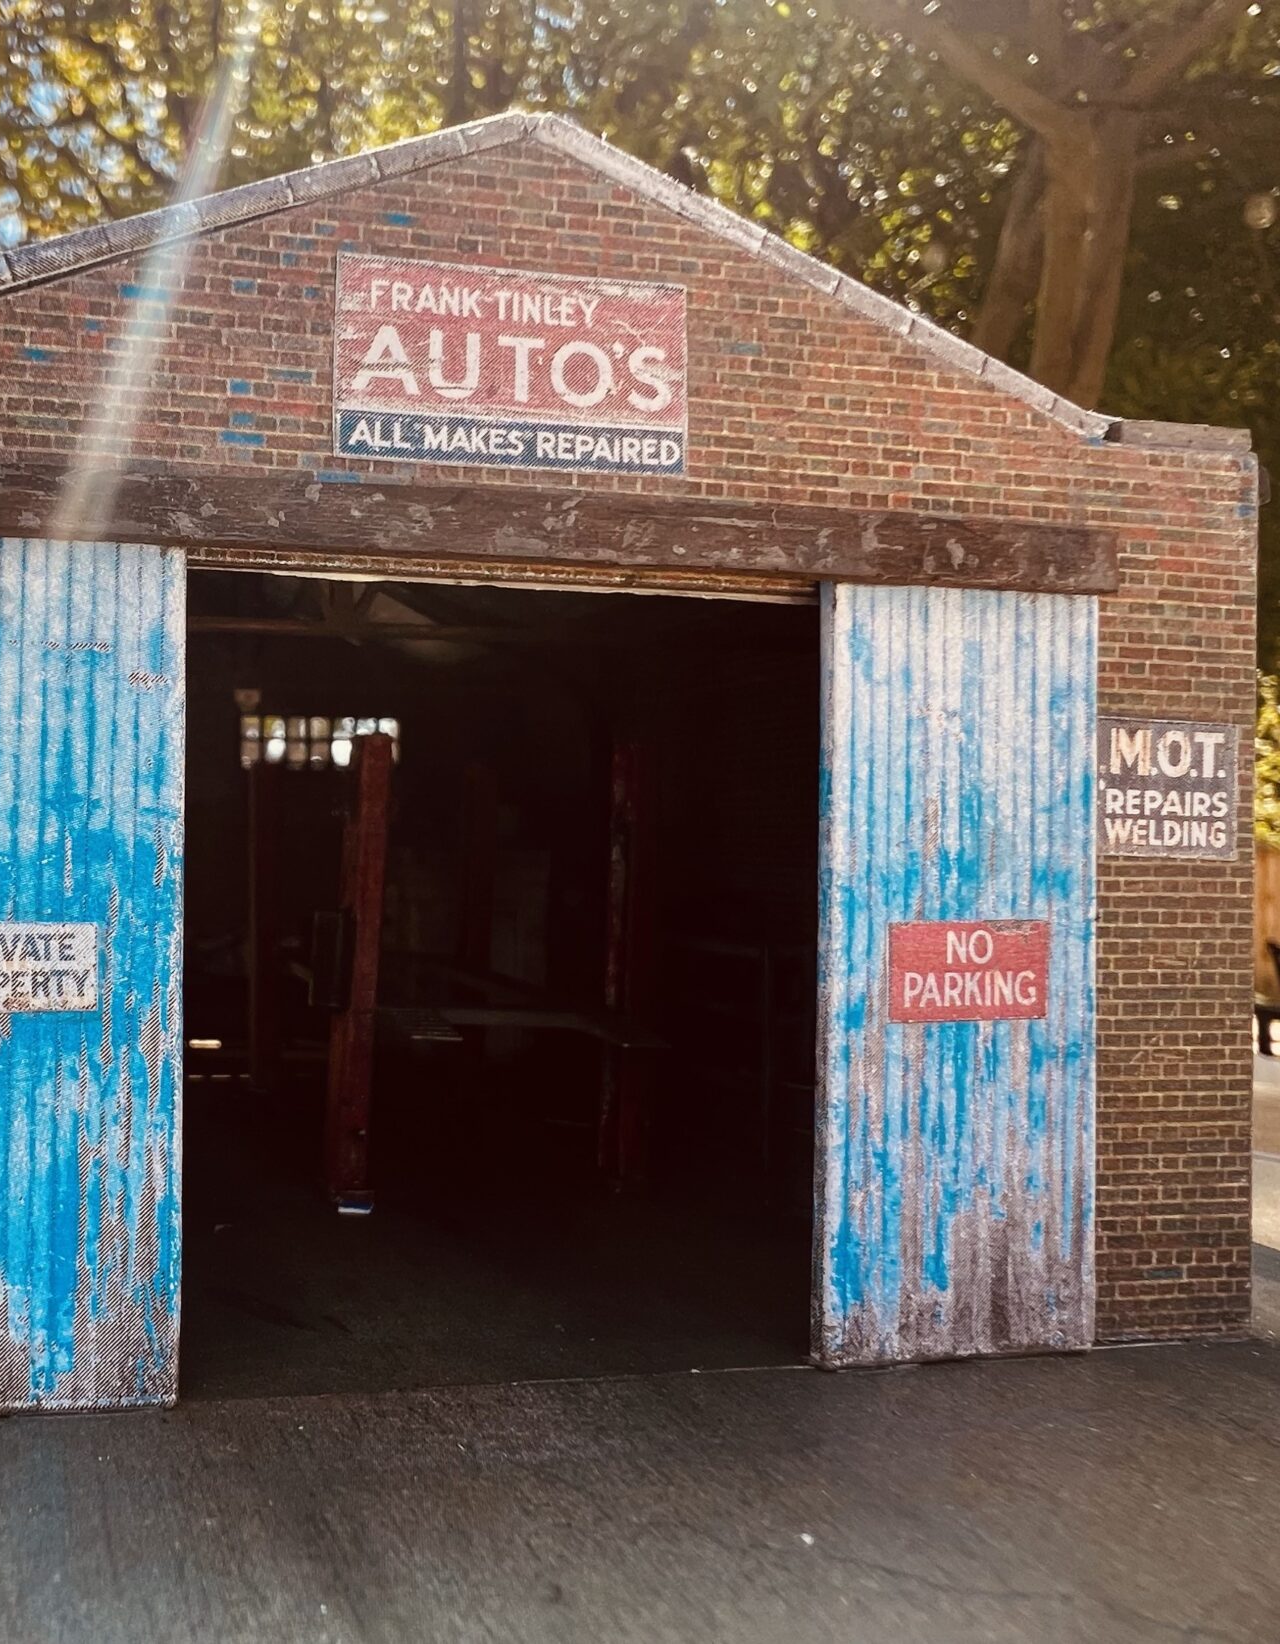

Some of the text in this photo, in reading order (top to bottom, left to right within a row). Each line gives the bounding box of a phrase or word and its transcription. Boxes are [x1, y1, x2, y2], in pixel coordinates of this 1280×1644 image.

[370, 278, 600, 329] FRANK TINLEY
[350, 324, 673, 412] AUTO'S
[348, 419, 682, 466] ALL MAKES REPAIRED
[1110, 727, 1227, 778] M.O.T.
[1105, 788, 1229, 818] REPAIRS
[1104, 818, 1227, 849] WELDING
[946, 929, 994, 965] NO
[903, 970, 1037, 1008] PARKING
